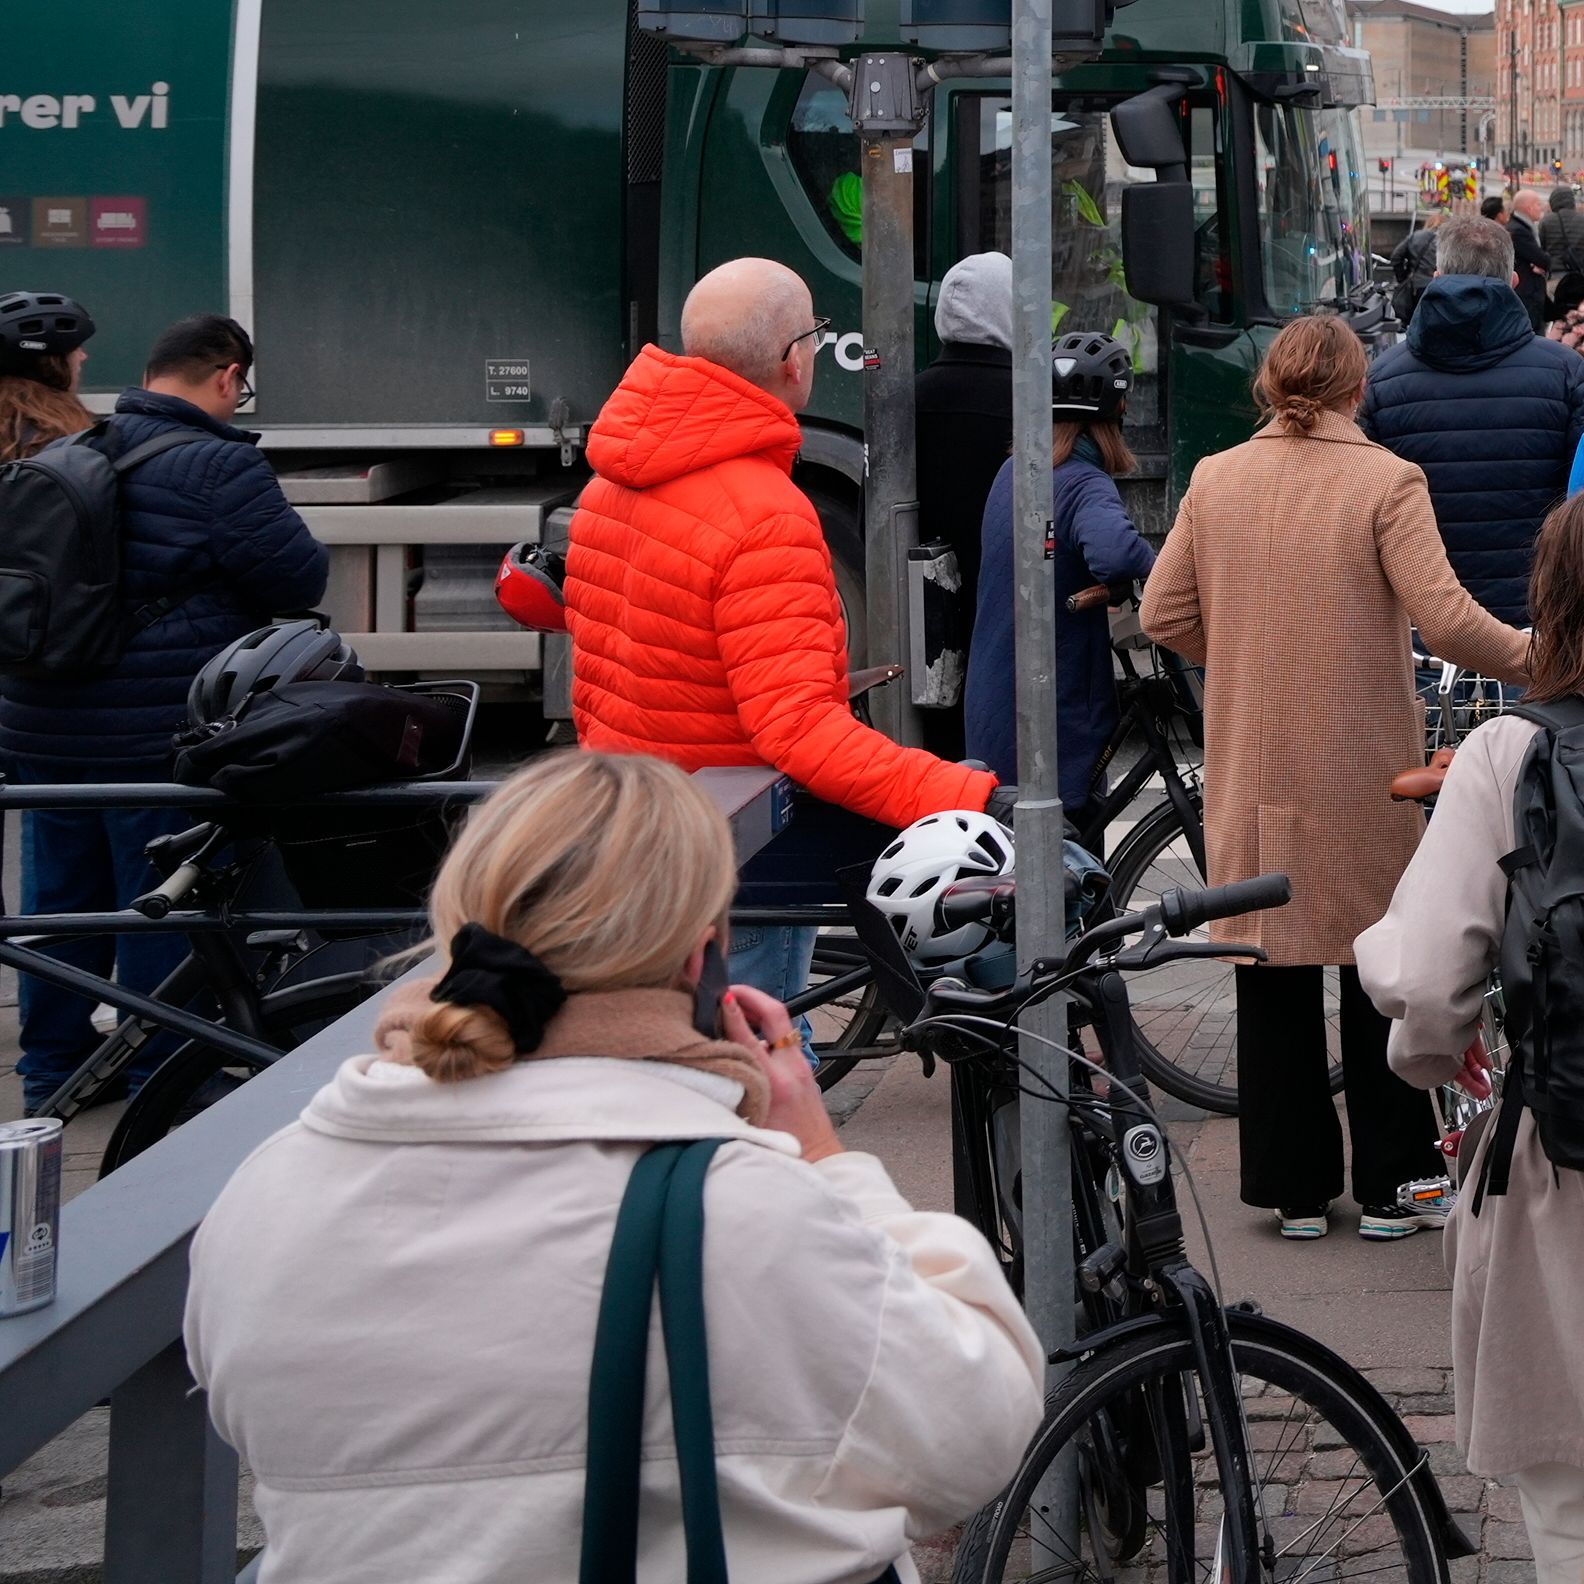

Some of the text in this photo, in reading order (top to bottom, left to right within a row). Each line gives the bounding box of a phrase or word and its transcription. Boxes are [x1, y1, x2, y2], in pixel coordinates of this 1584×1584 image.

[110, 81, 169, 129] vi
[498, 366, 528, 376] 27600
[504, 386, 529, 396] 9740
